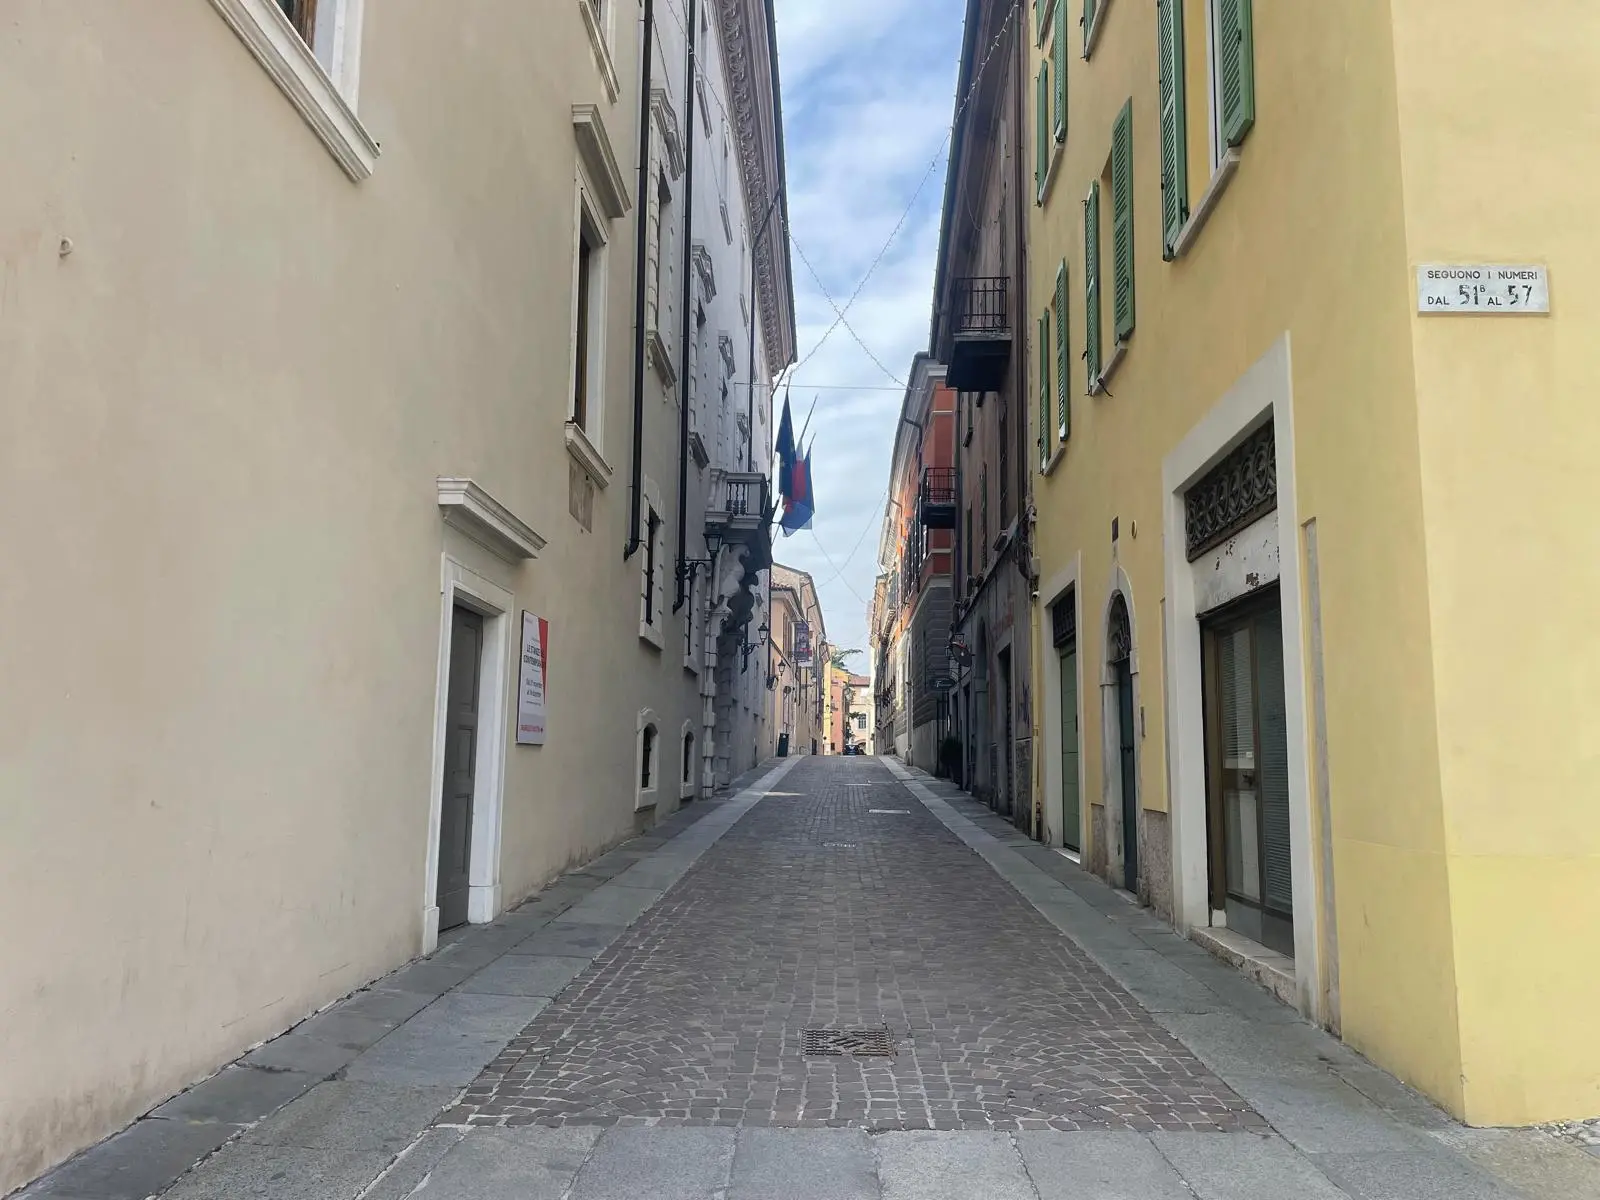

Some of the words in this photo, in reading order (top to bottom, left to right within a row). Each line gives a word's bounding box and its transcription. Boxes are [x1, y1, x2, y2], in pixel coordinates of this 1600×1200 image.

[1427, 270, 1481, 279] SEGUONO
[1498, 271, 1537, 280] NUMERI
[1427, 296, 1450, 305] DAL
[1487, 296, 1502, 306] AL
[1508, 284, 1533, 306] 57
